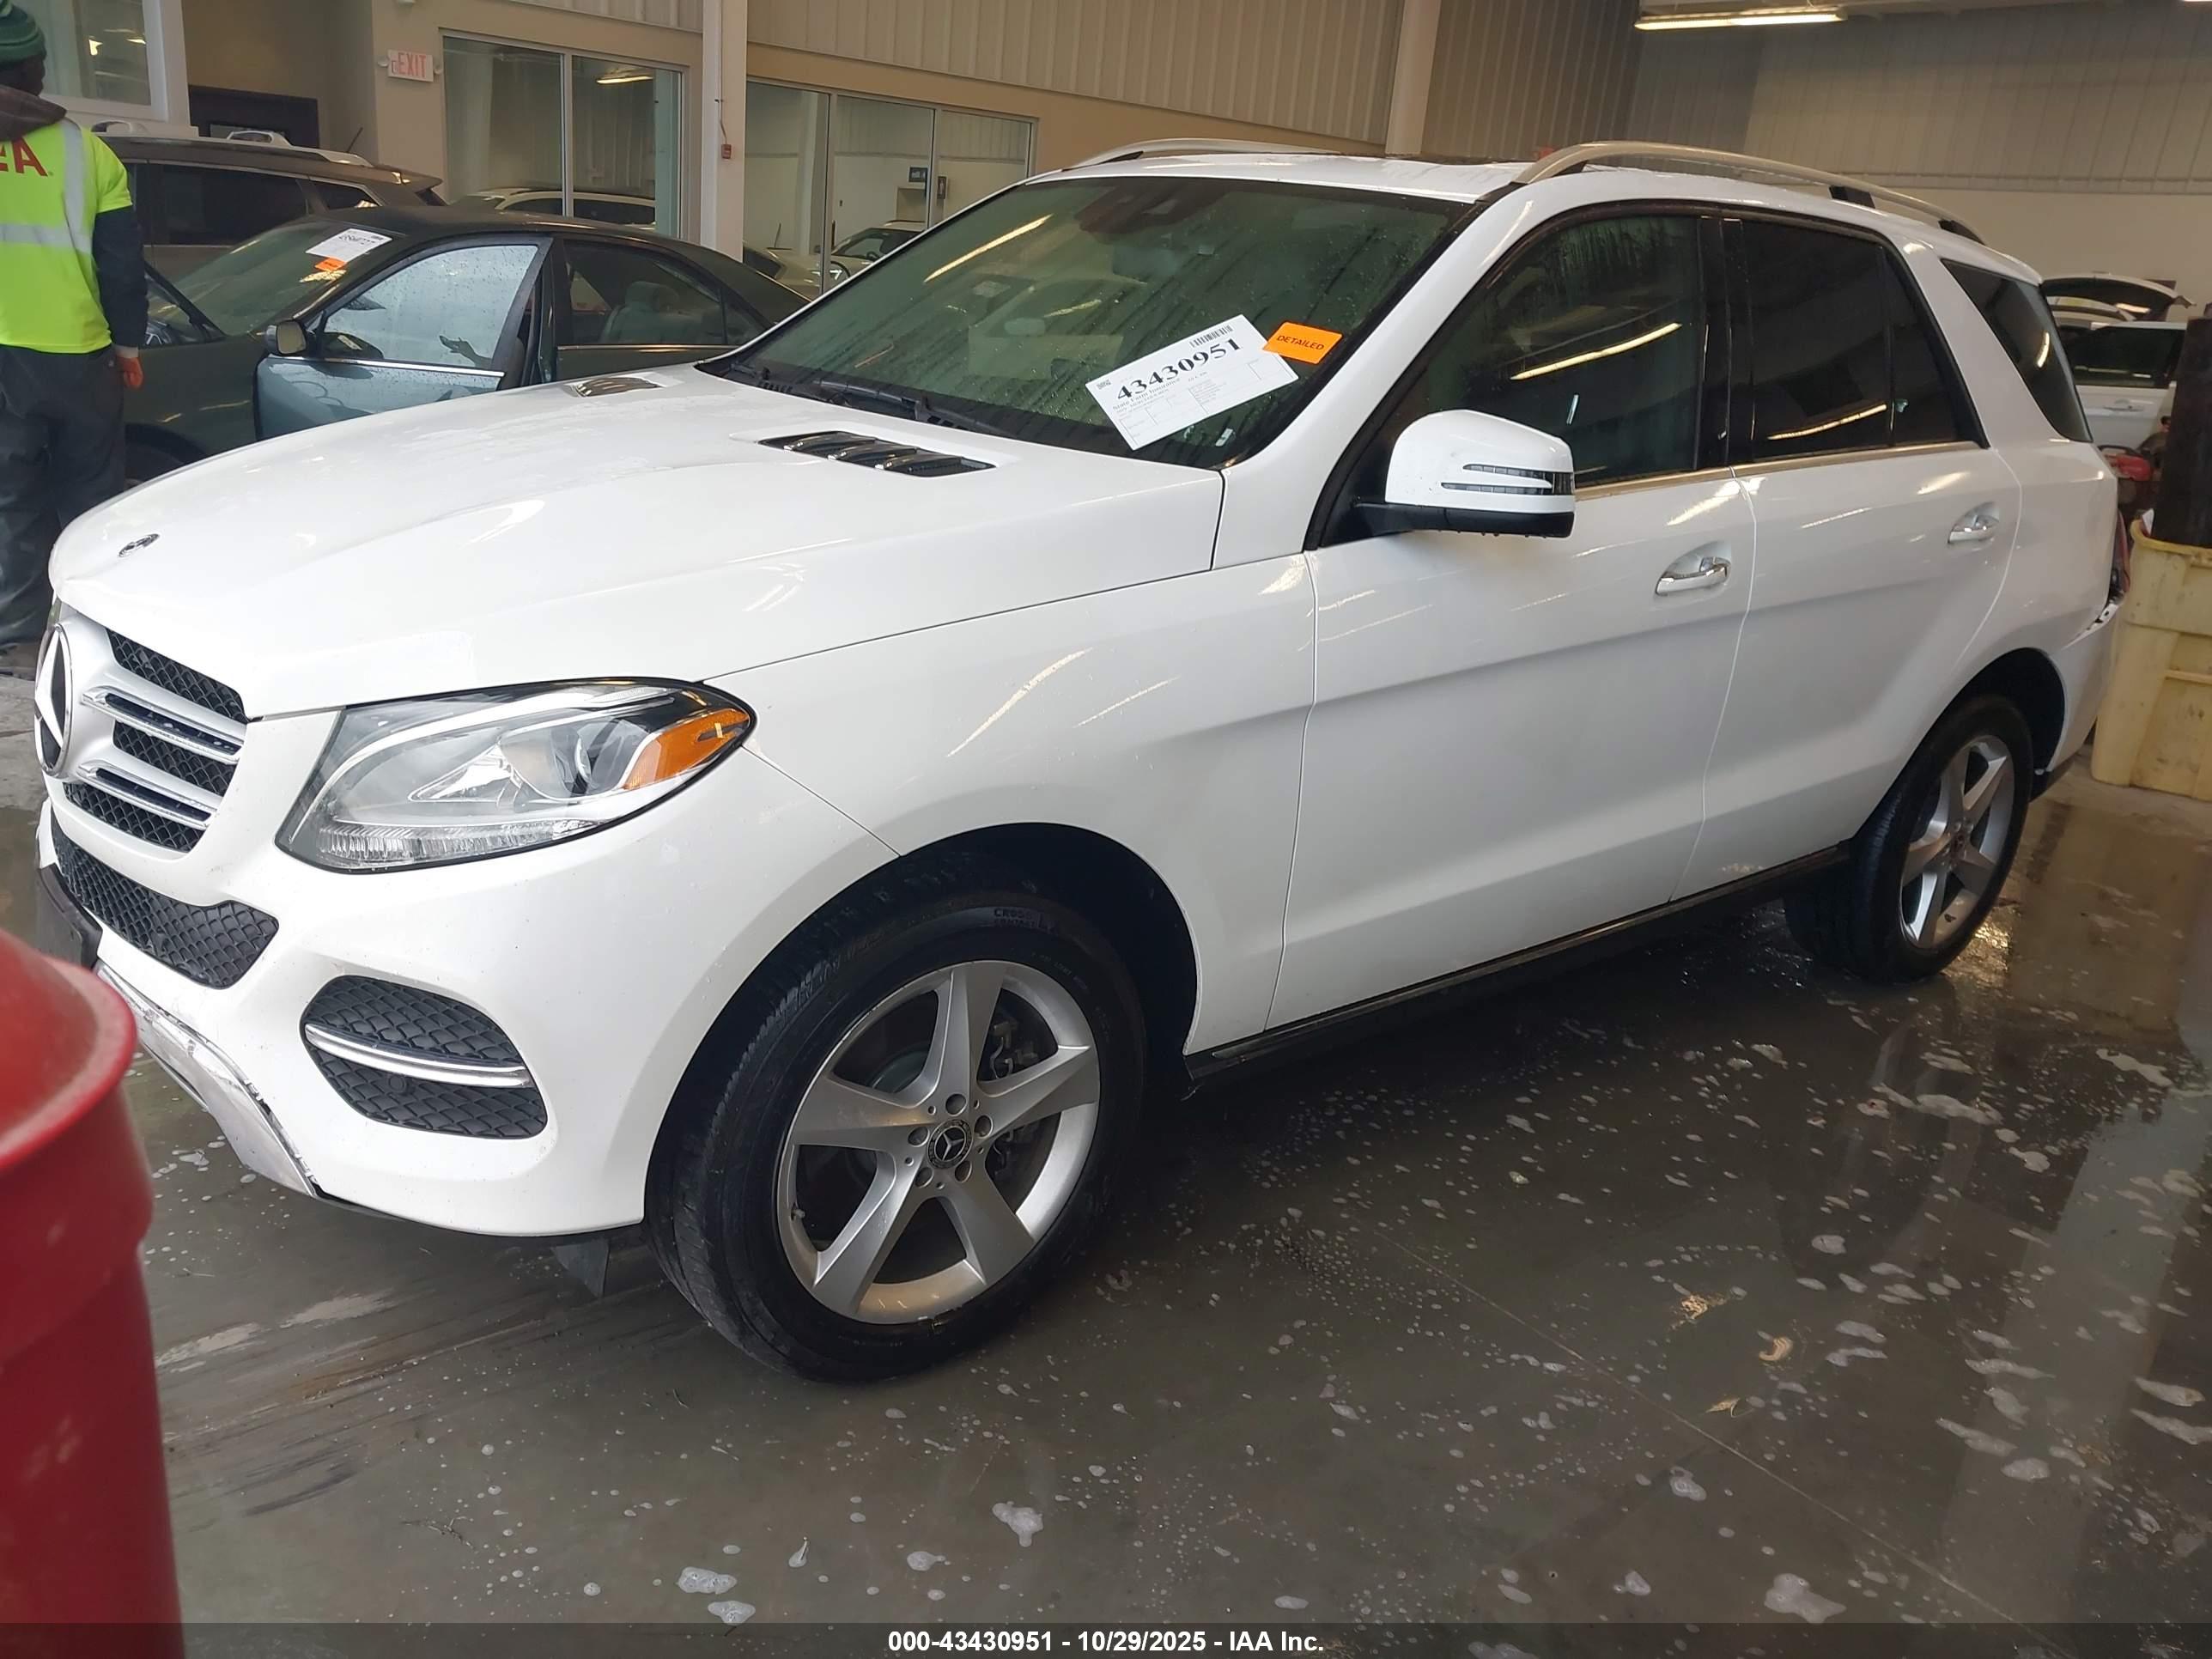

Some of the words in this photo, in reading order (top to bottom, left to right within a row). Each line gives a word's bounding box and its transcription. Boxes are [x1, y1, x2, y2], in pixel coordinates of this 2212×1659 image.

[398, 52, 426, 78] EXIT
[1275, 334, 1325, 351] DETAILED
[1117, 337, 1241, 400] 43430951
